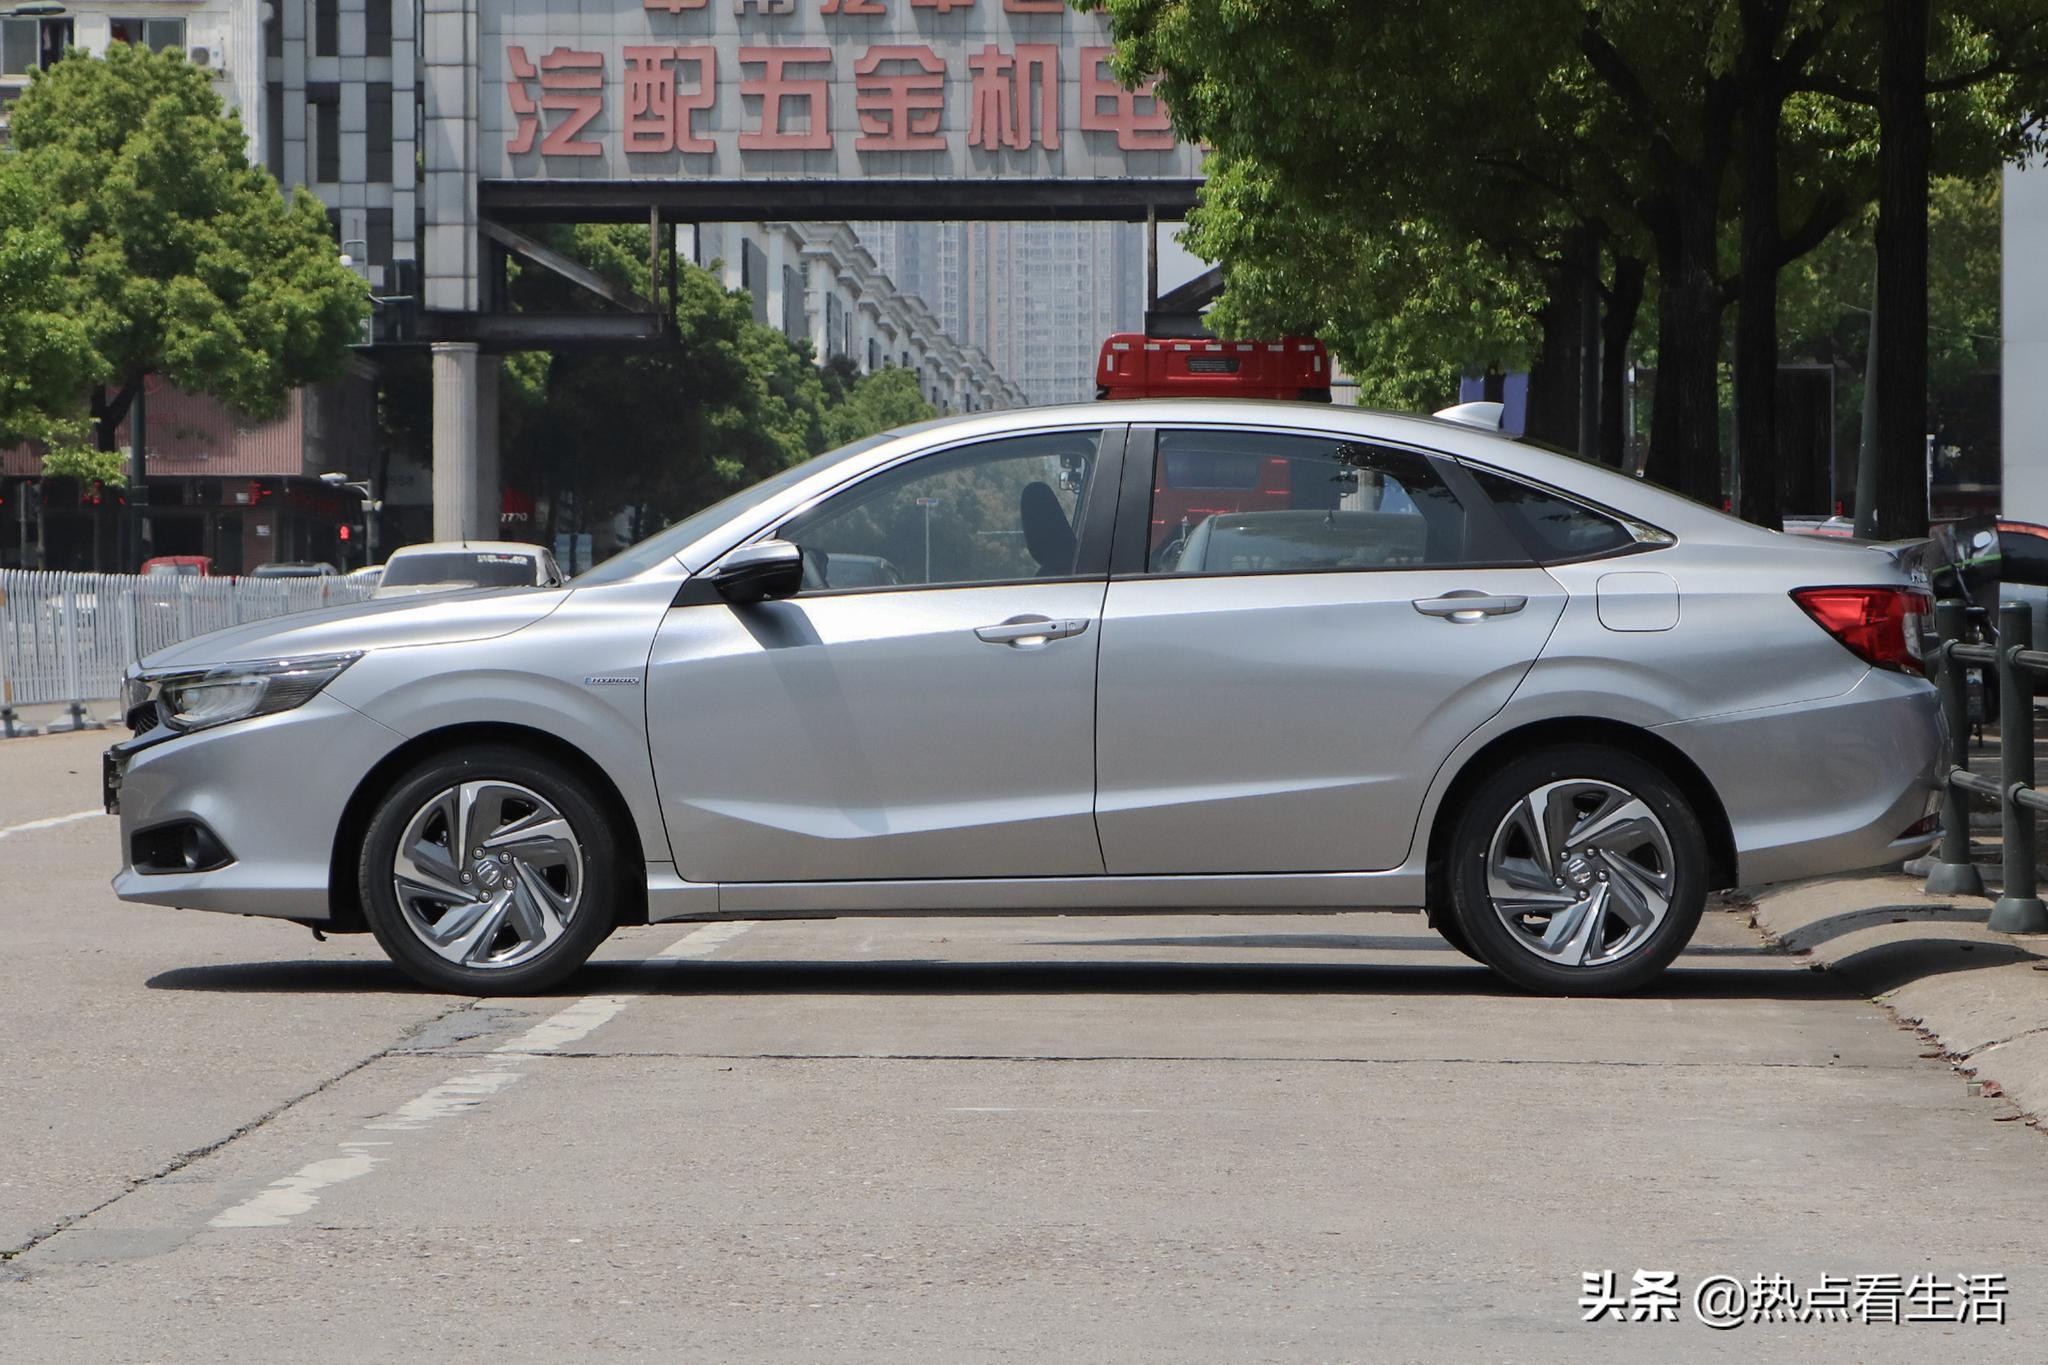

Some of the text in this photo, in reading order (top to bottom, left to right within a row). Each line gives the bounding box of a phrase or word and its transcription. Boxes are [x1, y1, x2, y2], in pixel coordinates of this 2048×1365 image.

[506, 44, 1216, 156] 汽配五金机电
